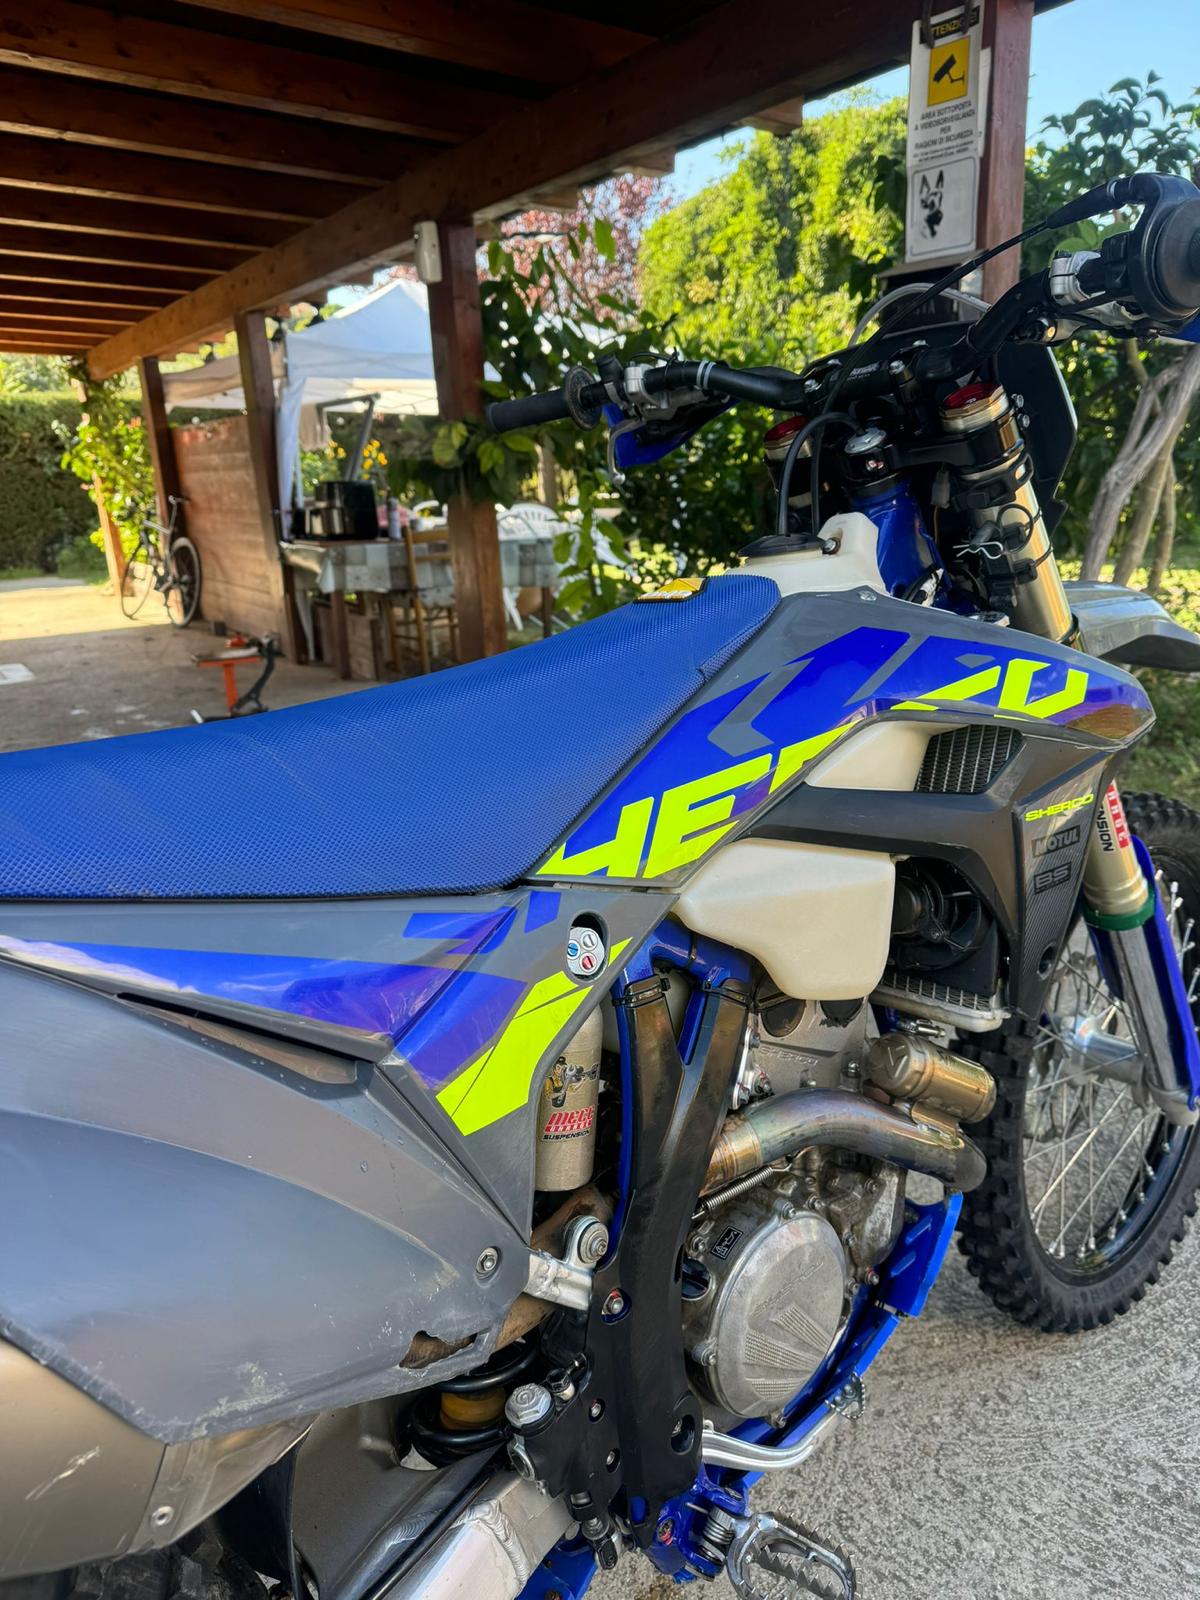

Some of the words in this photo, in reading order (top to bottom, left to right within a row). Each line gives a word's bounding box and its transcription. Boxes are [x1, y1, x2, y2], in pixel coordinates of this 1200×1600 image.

[921, 110, 936, 120] AREA
[940, 125, 951, 134] PER
[1025, 793, 1094, 822] SHERCO
[1035, 828, 1079, 856] MOTUL
[1035, 865, 1069, 889] BS
